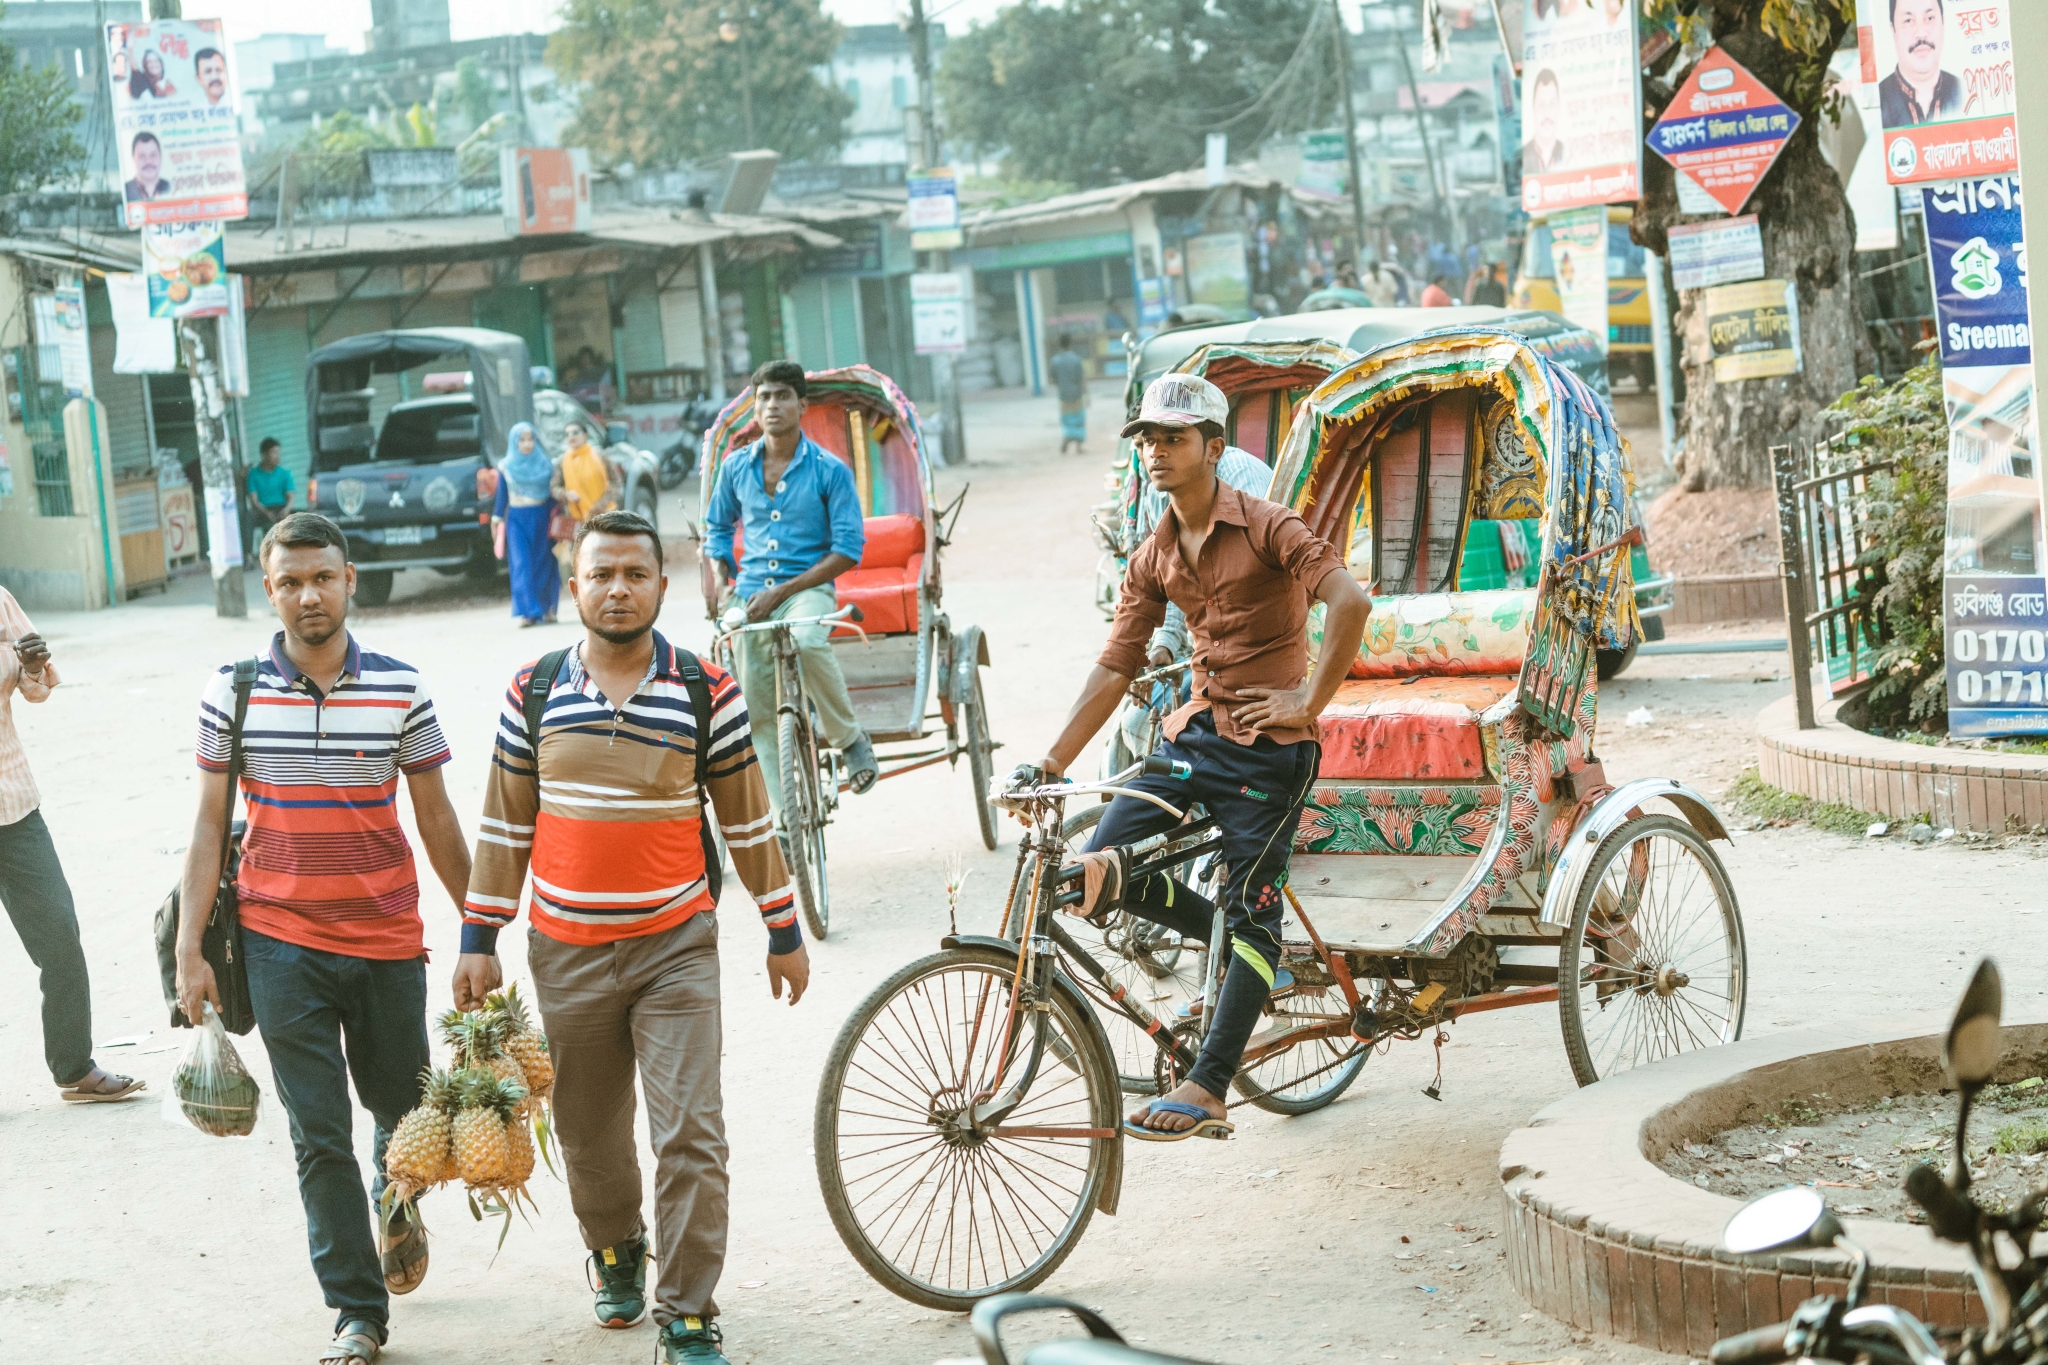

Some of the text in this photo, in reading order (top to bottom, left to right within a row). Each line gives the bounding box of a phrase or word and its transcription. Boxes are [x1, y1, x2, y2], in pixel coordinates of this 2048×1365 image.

[1659, 117, 1707, 149] হামদর্দ
[1922, 139, 1970, 170] বাংলাদেশ
[1711, 315, 1750, 345] হোটেল
[1947, 322, 2030, 351] Sreema
[1953, 584, 2045, 618] হবিগঞ্জ রোড
[1953, 629, 2048, 663] 0170
[1957, 669, 2048, 703] 0171
